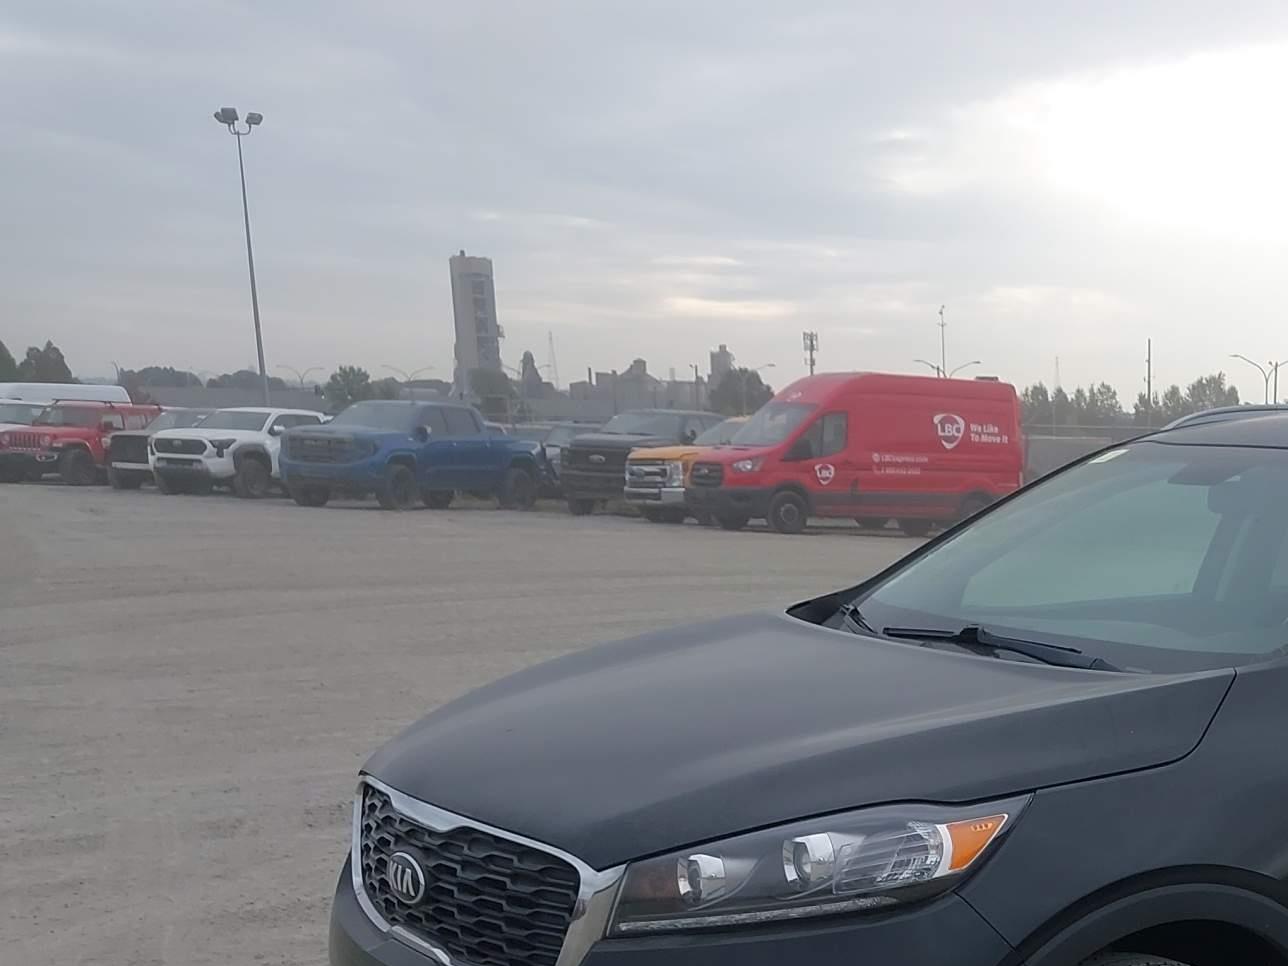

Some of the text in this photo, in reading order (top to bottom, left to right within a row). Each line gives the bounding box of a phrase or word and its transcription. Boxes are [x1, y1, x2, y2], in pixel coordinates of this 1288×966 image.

[937, 423, 961, 436] LBC
[970, 423, 999, 434] We Like
[970, 433, 980, 442] To
[388, 860, 416, 897] KIA
